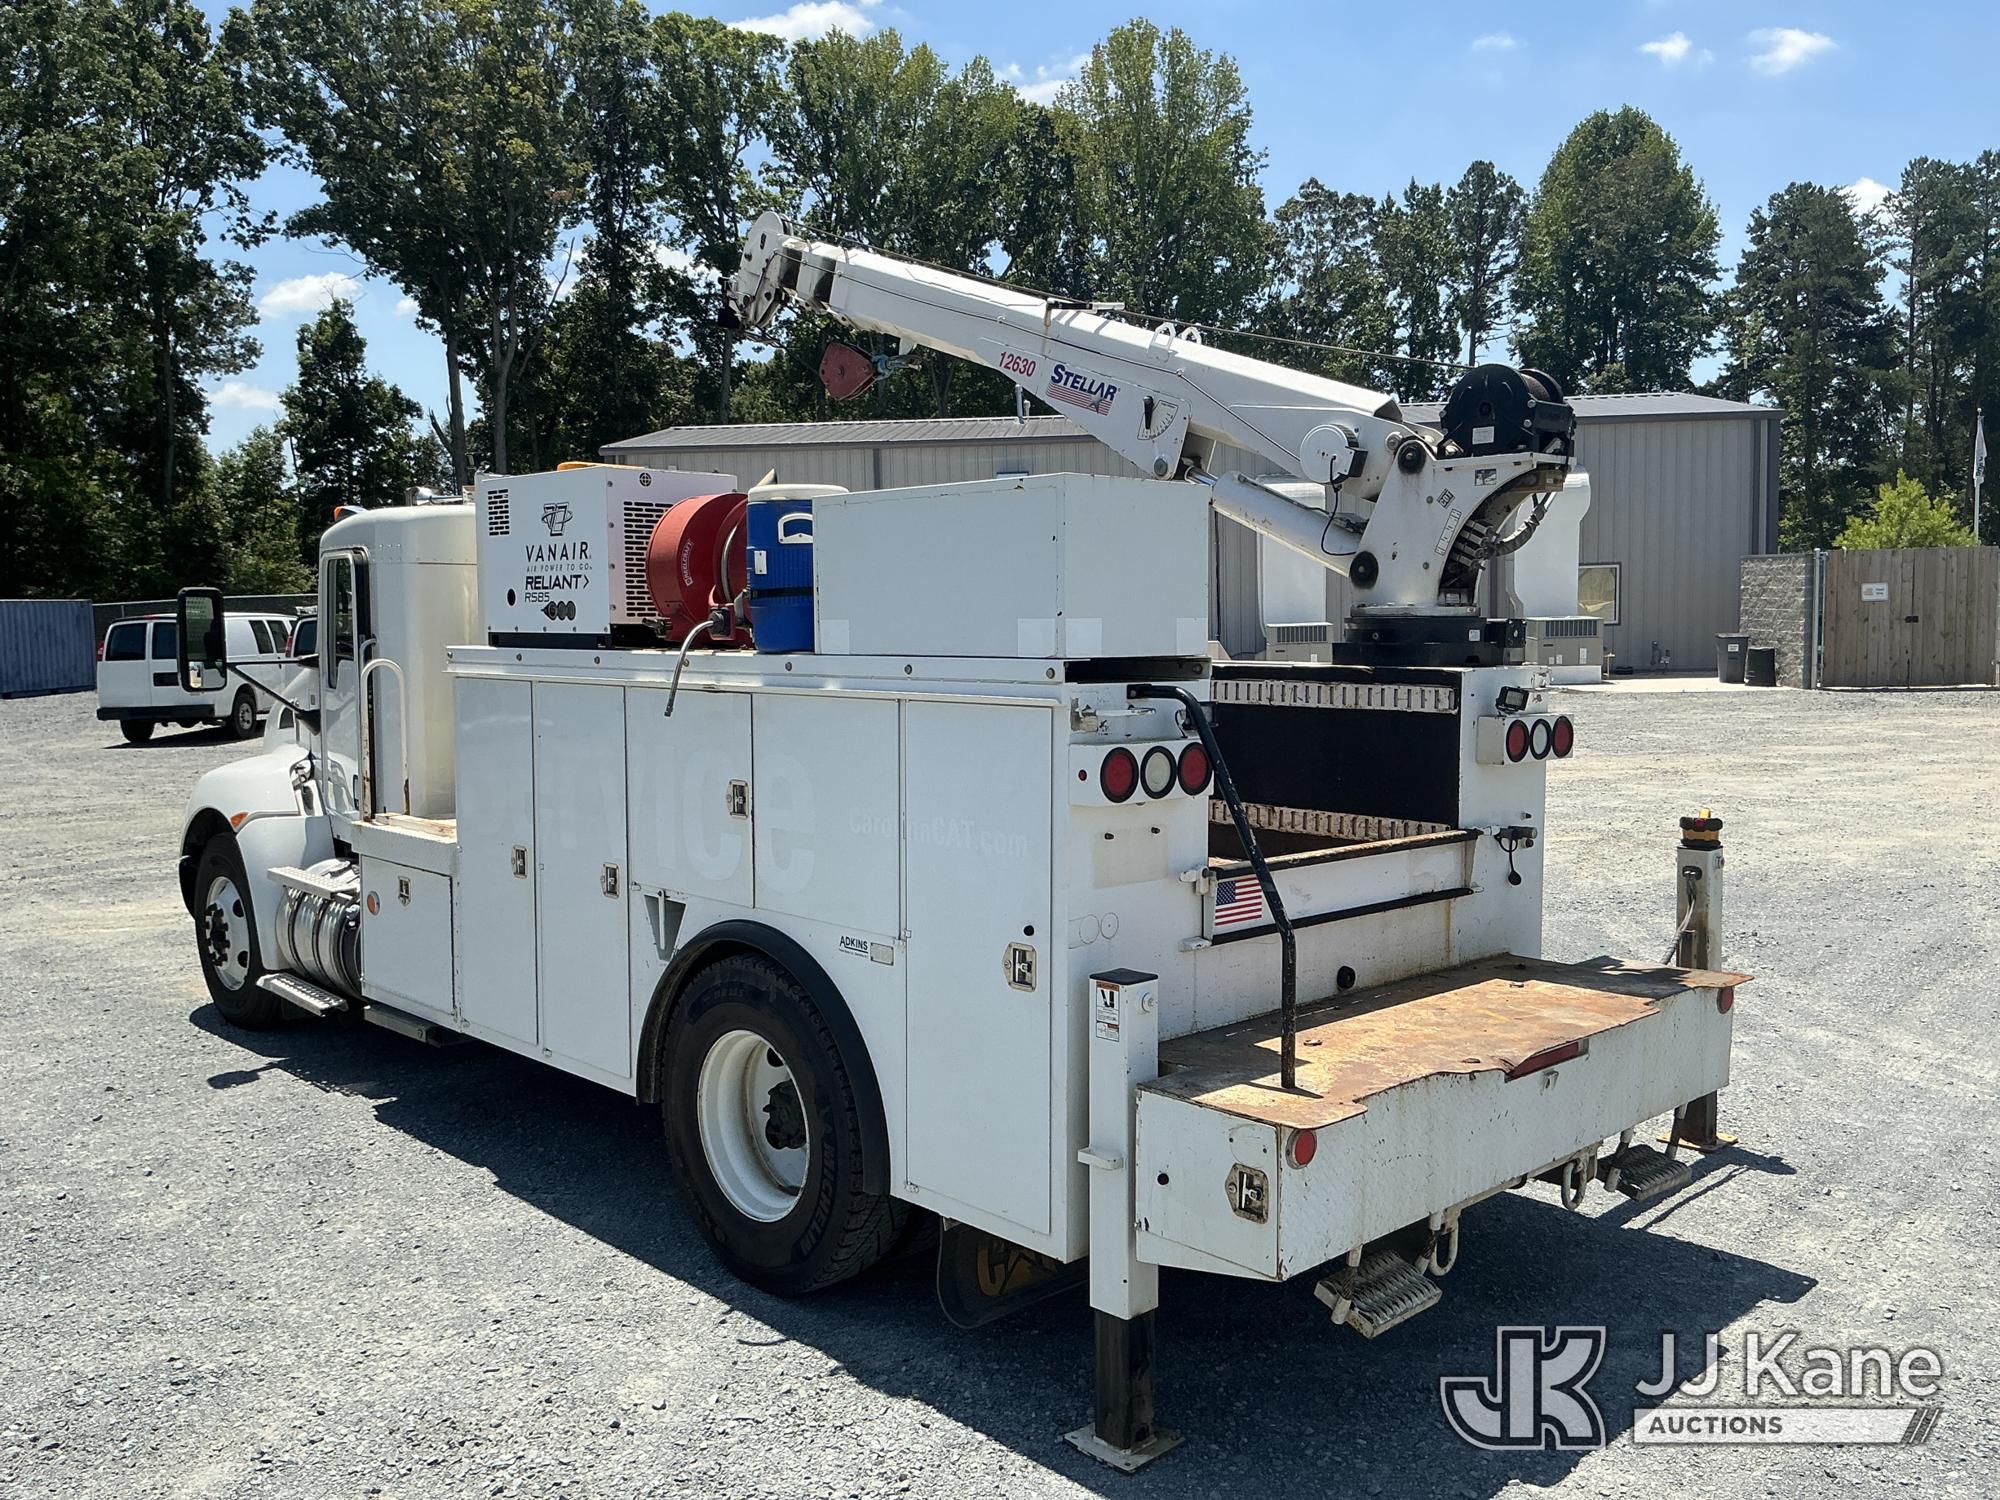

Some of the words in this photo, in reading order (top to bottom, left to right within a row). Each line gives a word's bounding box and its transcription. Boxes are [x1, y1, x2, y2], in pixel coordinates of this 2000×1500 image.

[999, 351, 1036, 377] 12630
[1051, 364, 1117, 401] STELLAR
[526, 541, 588, 562] VANAIR
[839, 935, 868, 951] ADKINS
[799, 1142, 836, 1257] MICHELIN
